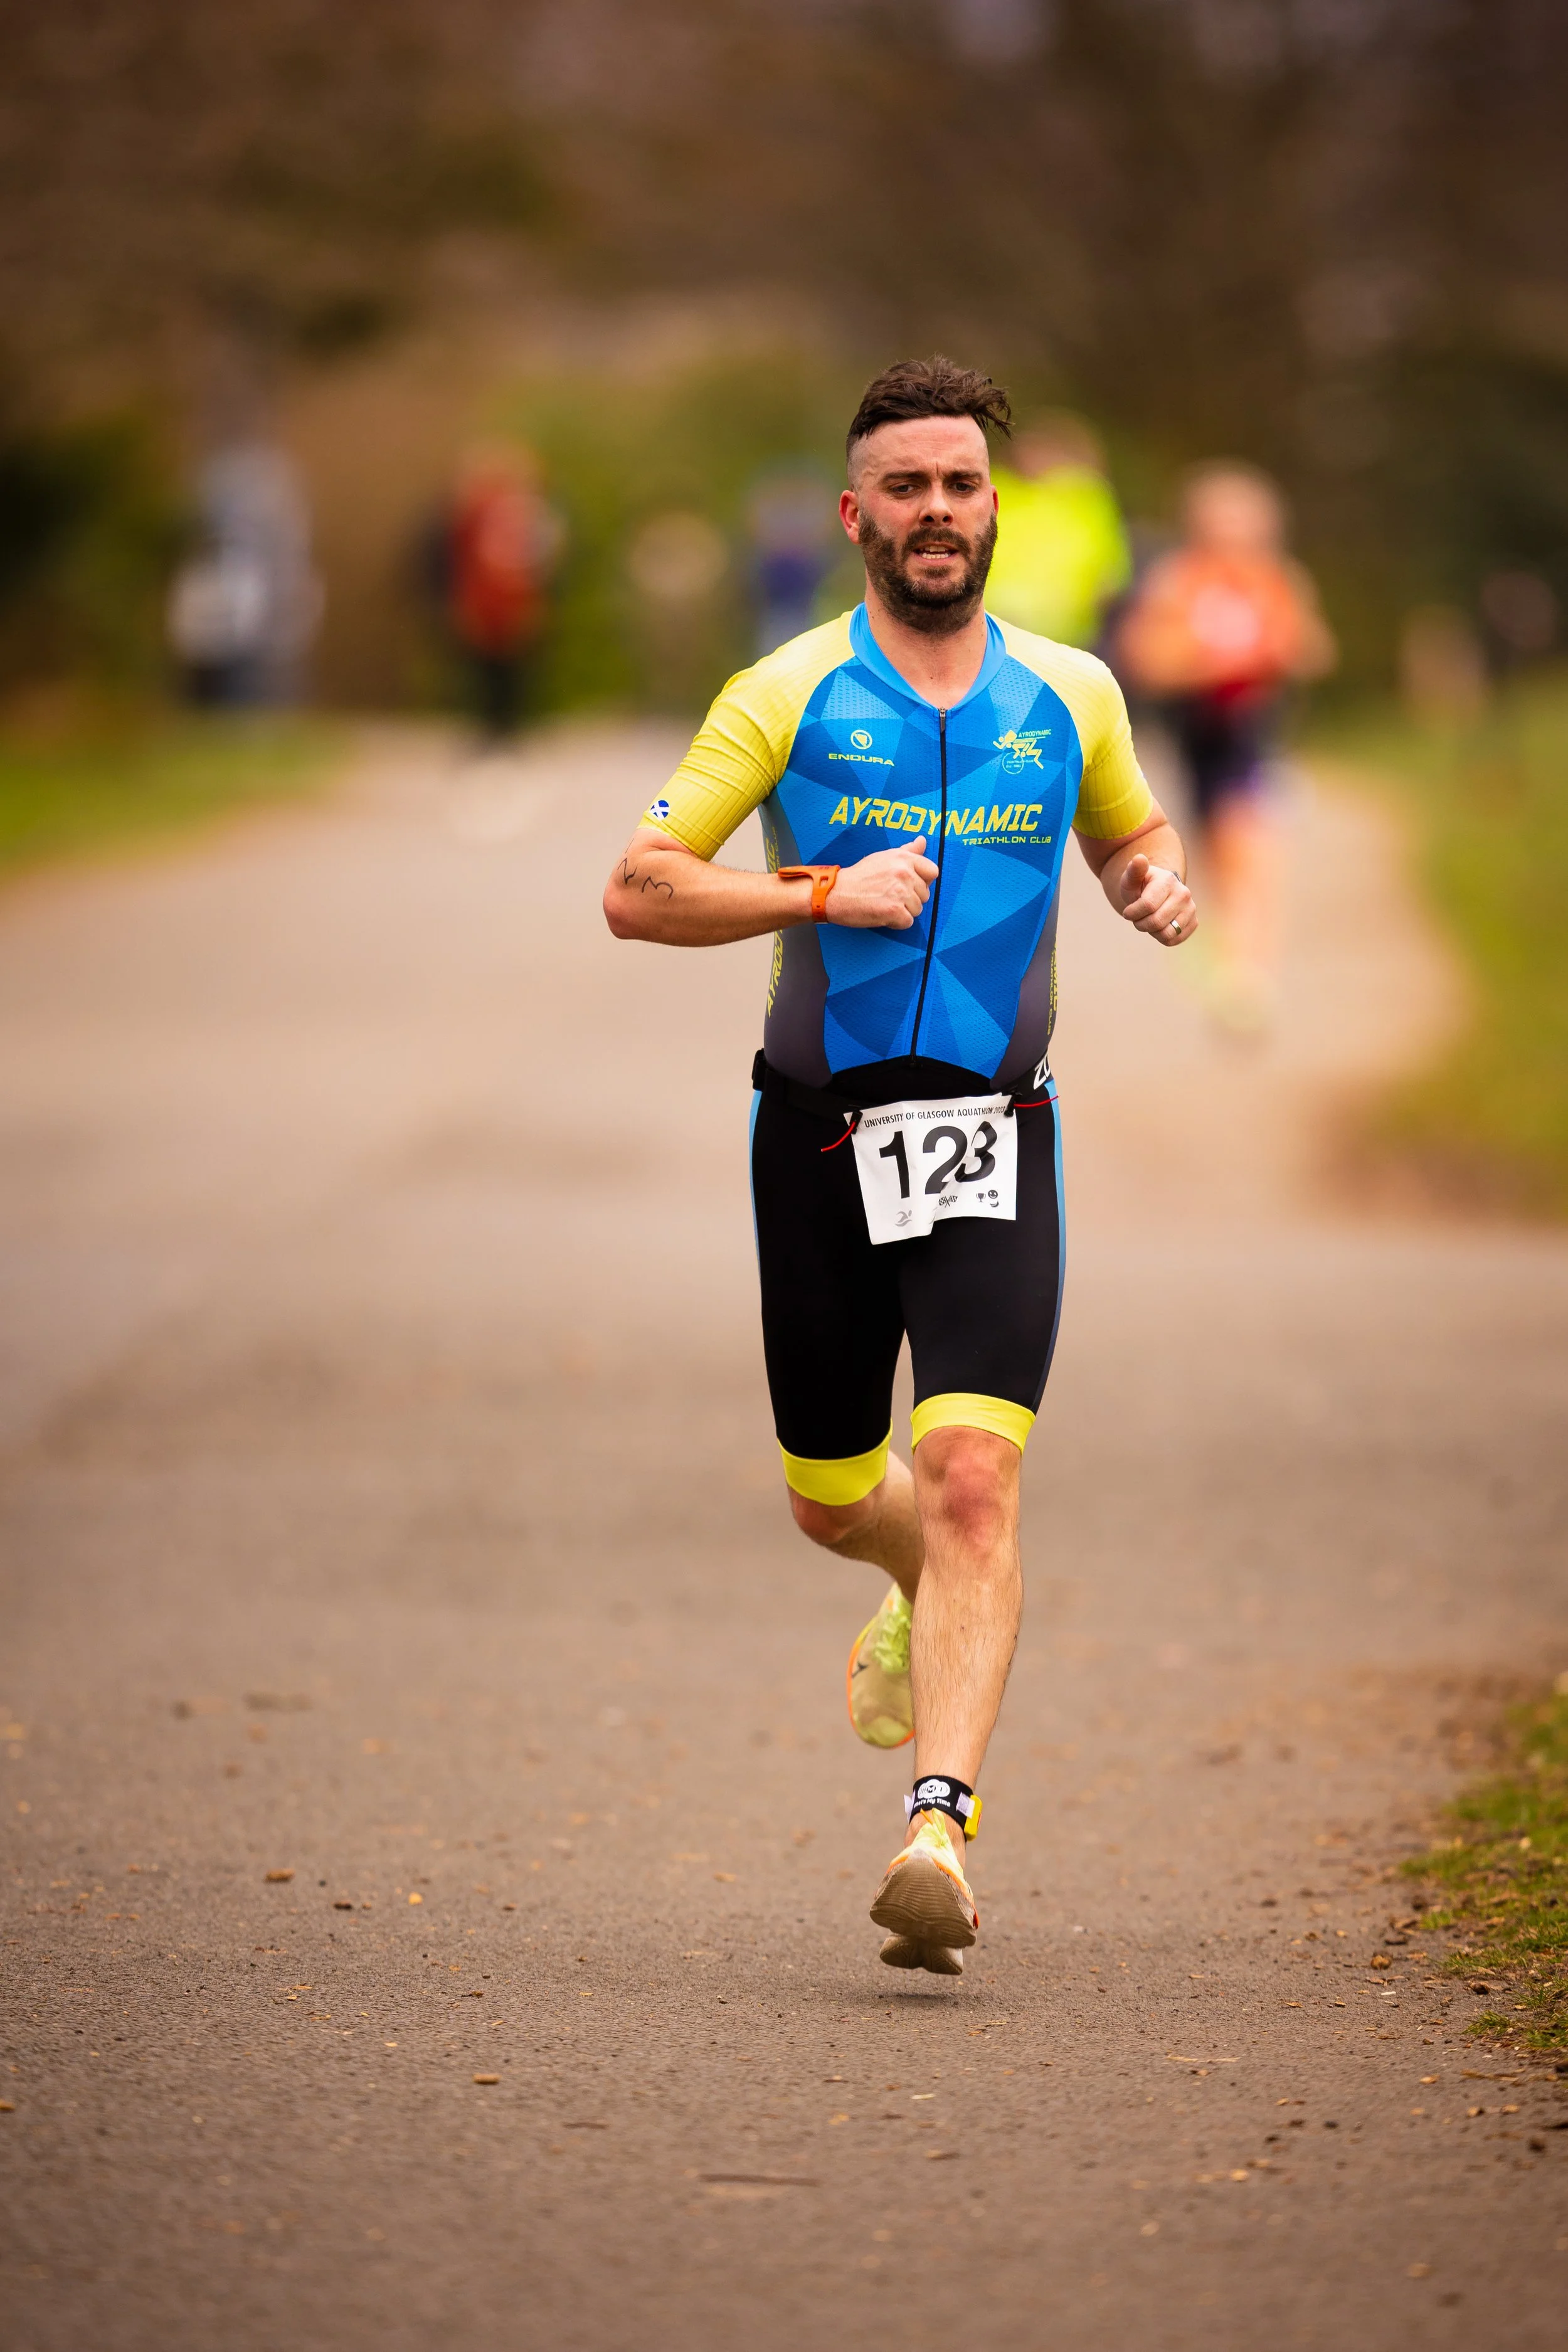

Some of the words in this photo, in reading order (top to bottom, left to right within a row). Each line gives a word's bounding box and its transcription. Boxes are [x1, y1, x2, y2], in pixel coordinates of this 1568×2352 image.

[828, 753, 894, 766] ENDURA
[829, 797, 1043, 836] AYRODYNAMIC
[962, 836, 1026, 845] TRIATHLON
[864, 1113, 903, 1128] UNIVERSITY
[906, 1112, 915, 1120] OF
[918, 1109, 954, 1120] GLASGOW
[879, 1121, 997, 1199] 123
